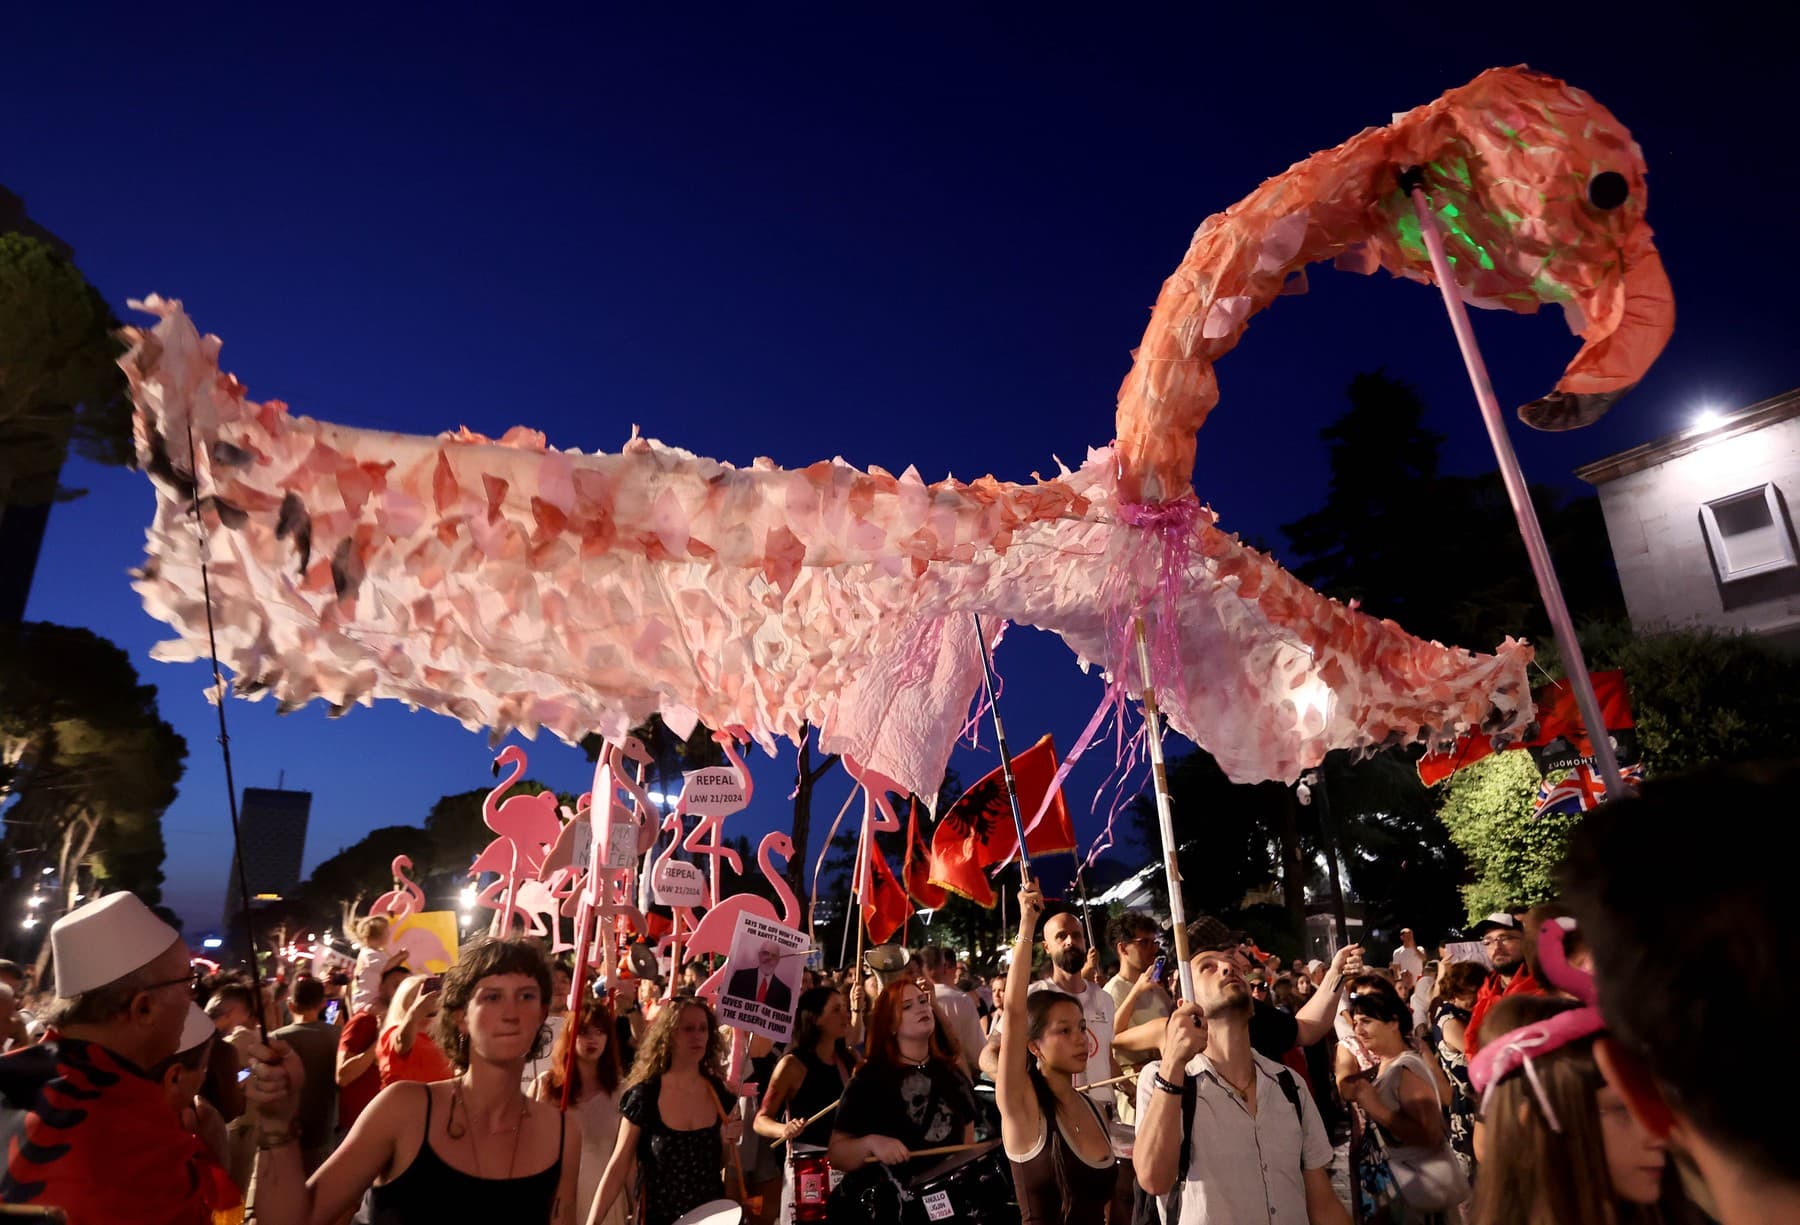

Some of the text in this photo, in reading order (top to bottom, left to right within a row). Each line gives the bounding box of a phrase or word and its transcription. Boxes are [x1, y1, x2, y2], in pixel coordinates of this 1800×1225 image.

[696, 775, 735, 786] REPEAL
[690, 794, 742, 804] LAW 21/2024
[666, 868, 696, 880] REPEAL
[658, 885, 673, 893] LAW
[745, 919, 804, 944] SAYS THE GUY WON'T PAY
[747, 928, 757, 936] FOR
[778, 937, 798, 949] CONCERT
[721, 996, 792, 1024] GIVES OUT 4M FROM
[723, 1008, 787, 1034] THE RESERVE FUND
